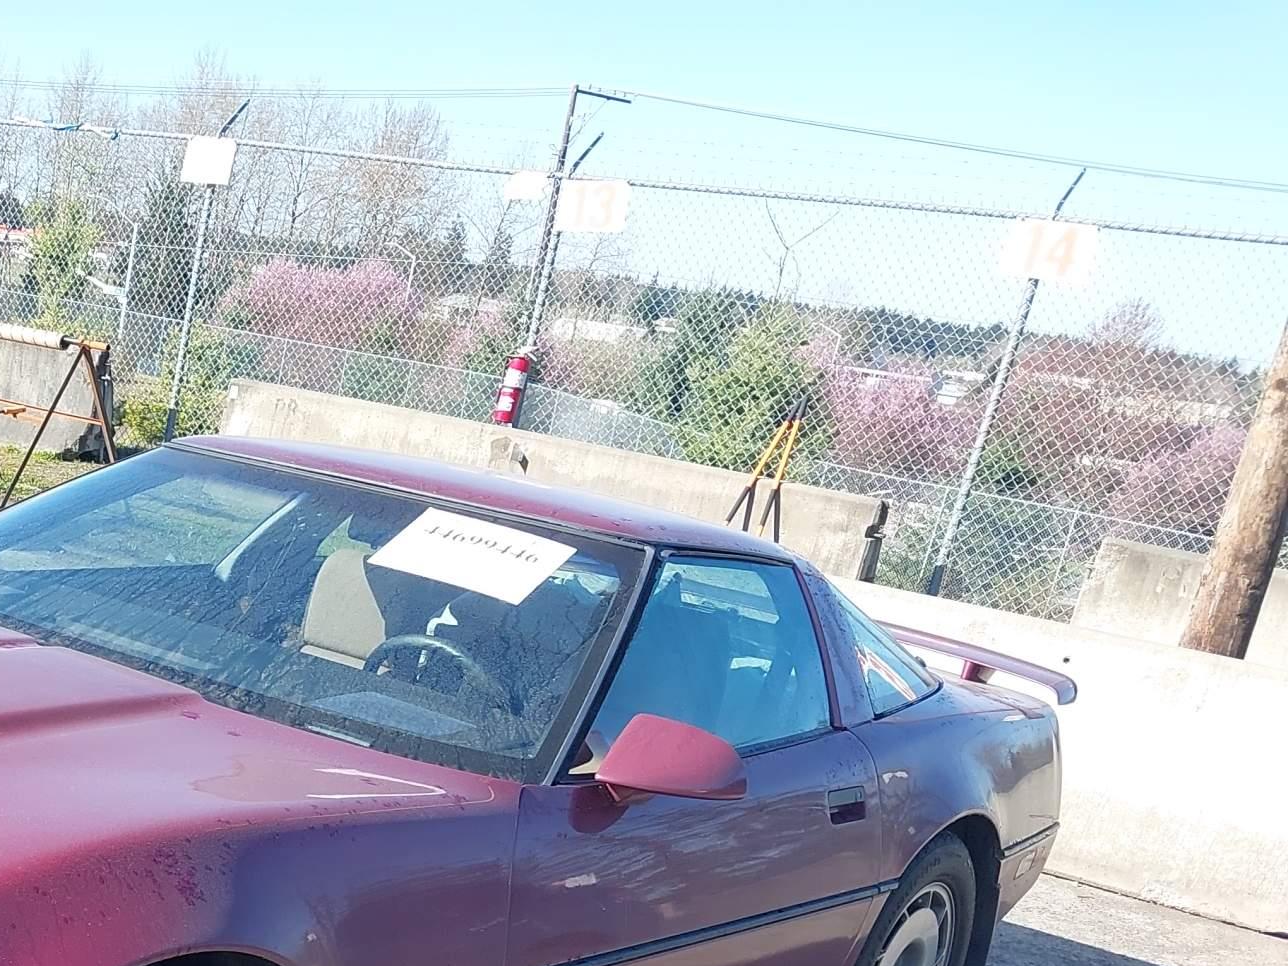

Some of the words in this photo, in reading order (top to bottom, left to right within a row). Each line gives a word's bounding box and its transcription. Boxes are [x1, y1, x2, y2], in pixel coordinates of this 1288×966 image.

[573, 183, 617, 229] 13
[1024, 223, 1078, 277] 14
[424, 525, 540, 564] 44699446
